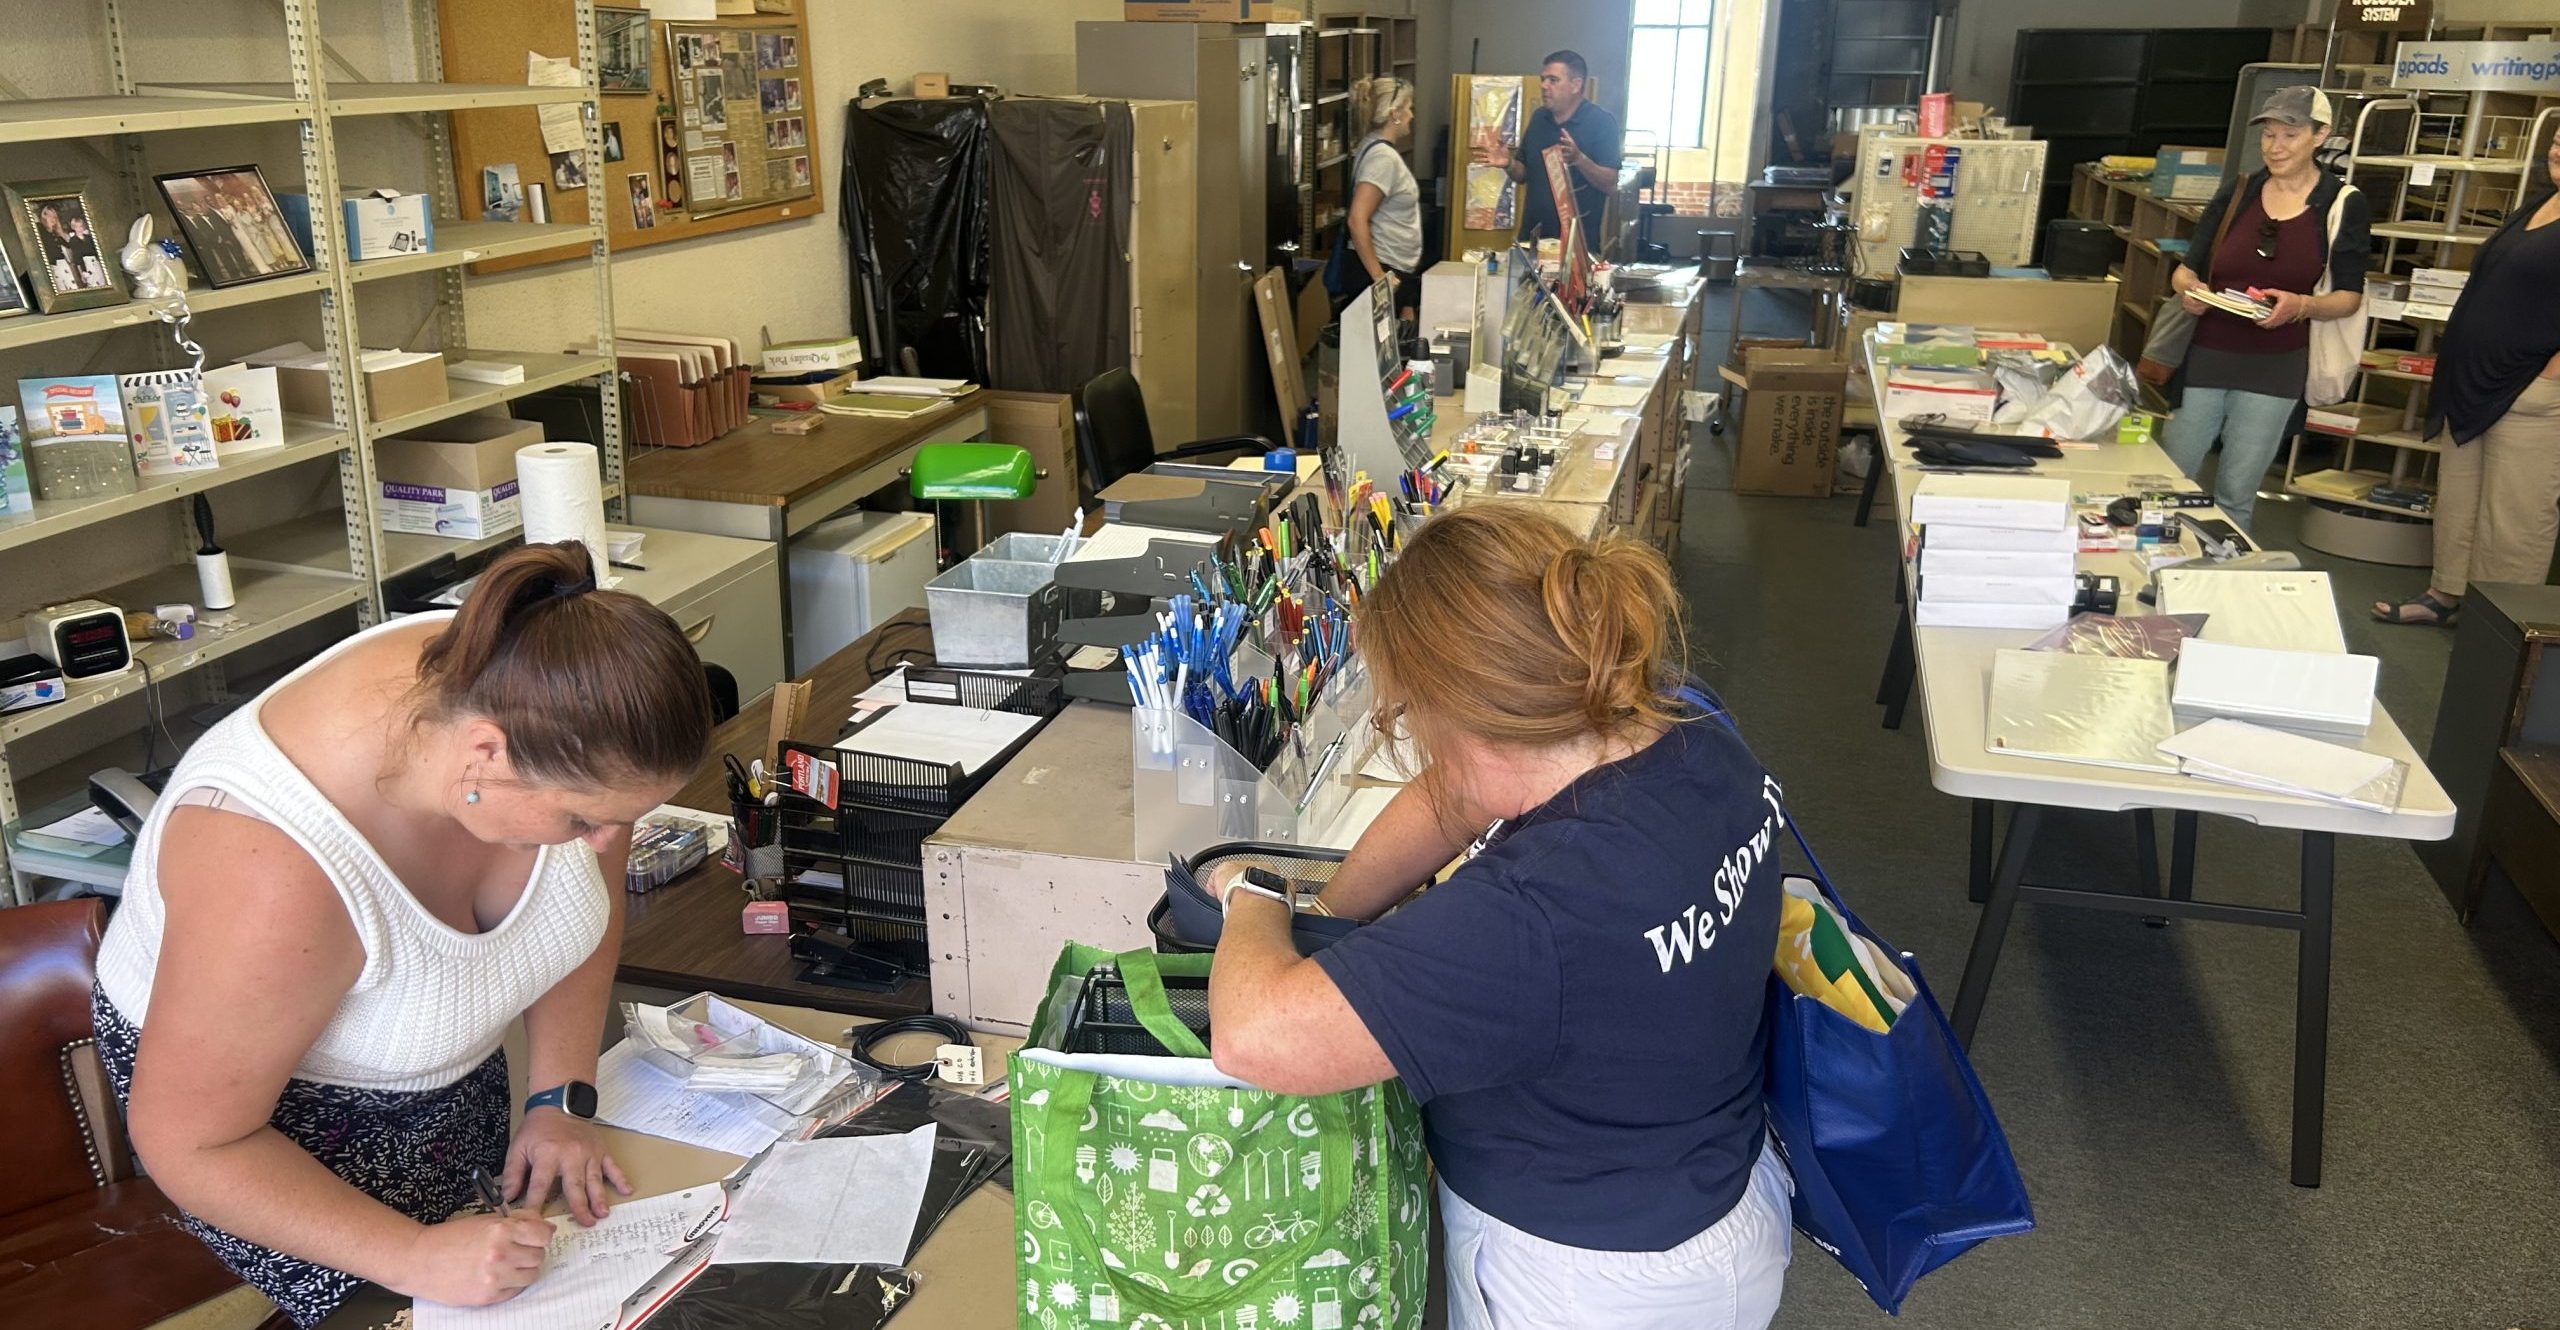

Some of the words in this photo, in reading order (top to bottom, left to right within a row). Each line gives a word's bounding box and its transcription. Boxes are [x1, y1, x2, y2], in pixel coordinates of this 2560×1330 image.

[2361, 8, 2400, 22] SYSTEM
[790, 353, 820, 365] Quality
[1774, 395, 1785, 415] we
[1823, 396, 1836, 418] the
[1781, 395, 1801, 465] everything
[1803, 409, 1818, 446] inside
[1816, 421, 1831, 468] outside
[384, 484, 421, 495] QUALITY
[422, 487, 444, 498] PARK
[493, 481, 517, 496] QUALITY
[797, 754, 805, 790] PORTLAND
[1644, 904, 1716, 973] We
[1714, 816, 1771, 926] Show
[687, 1205, 721, 1239] innovera
